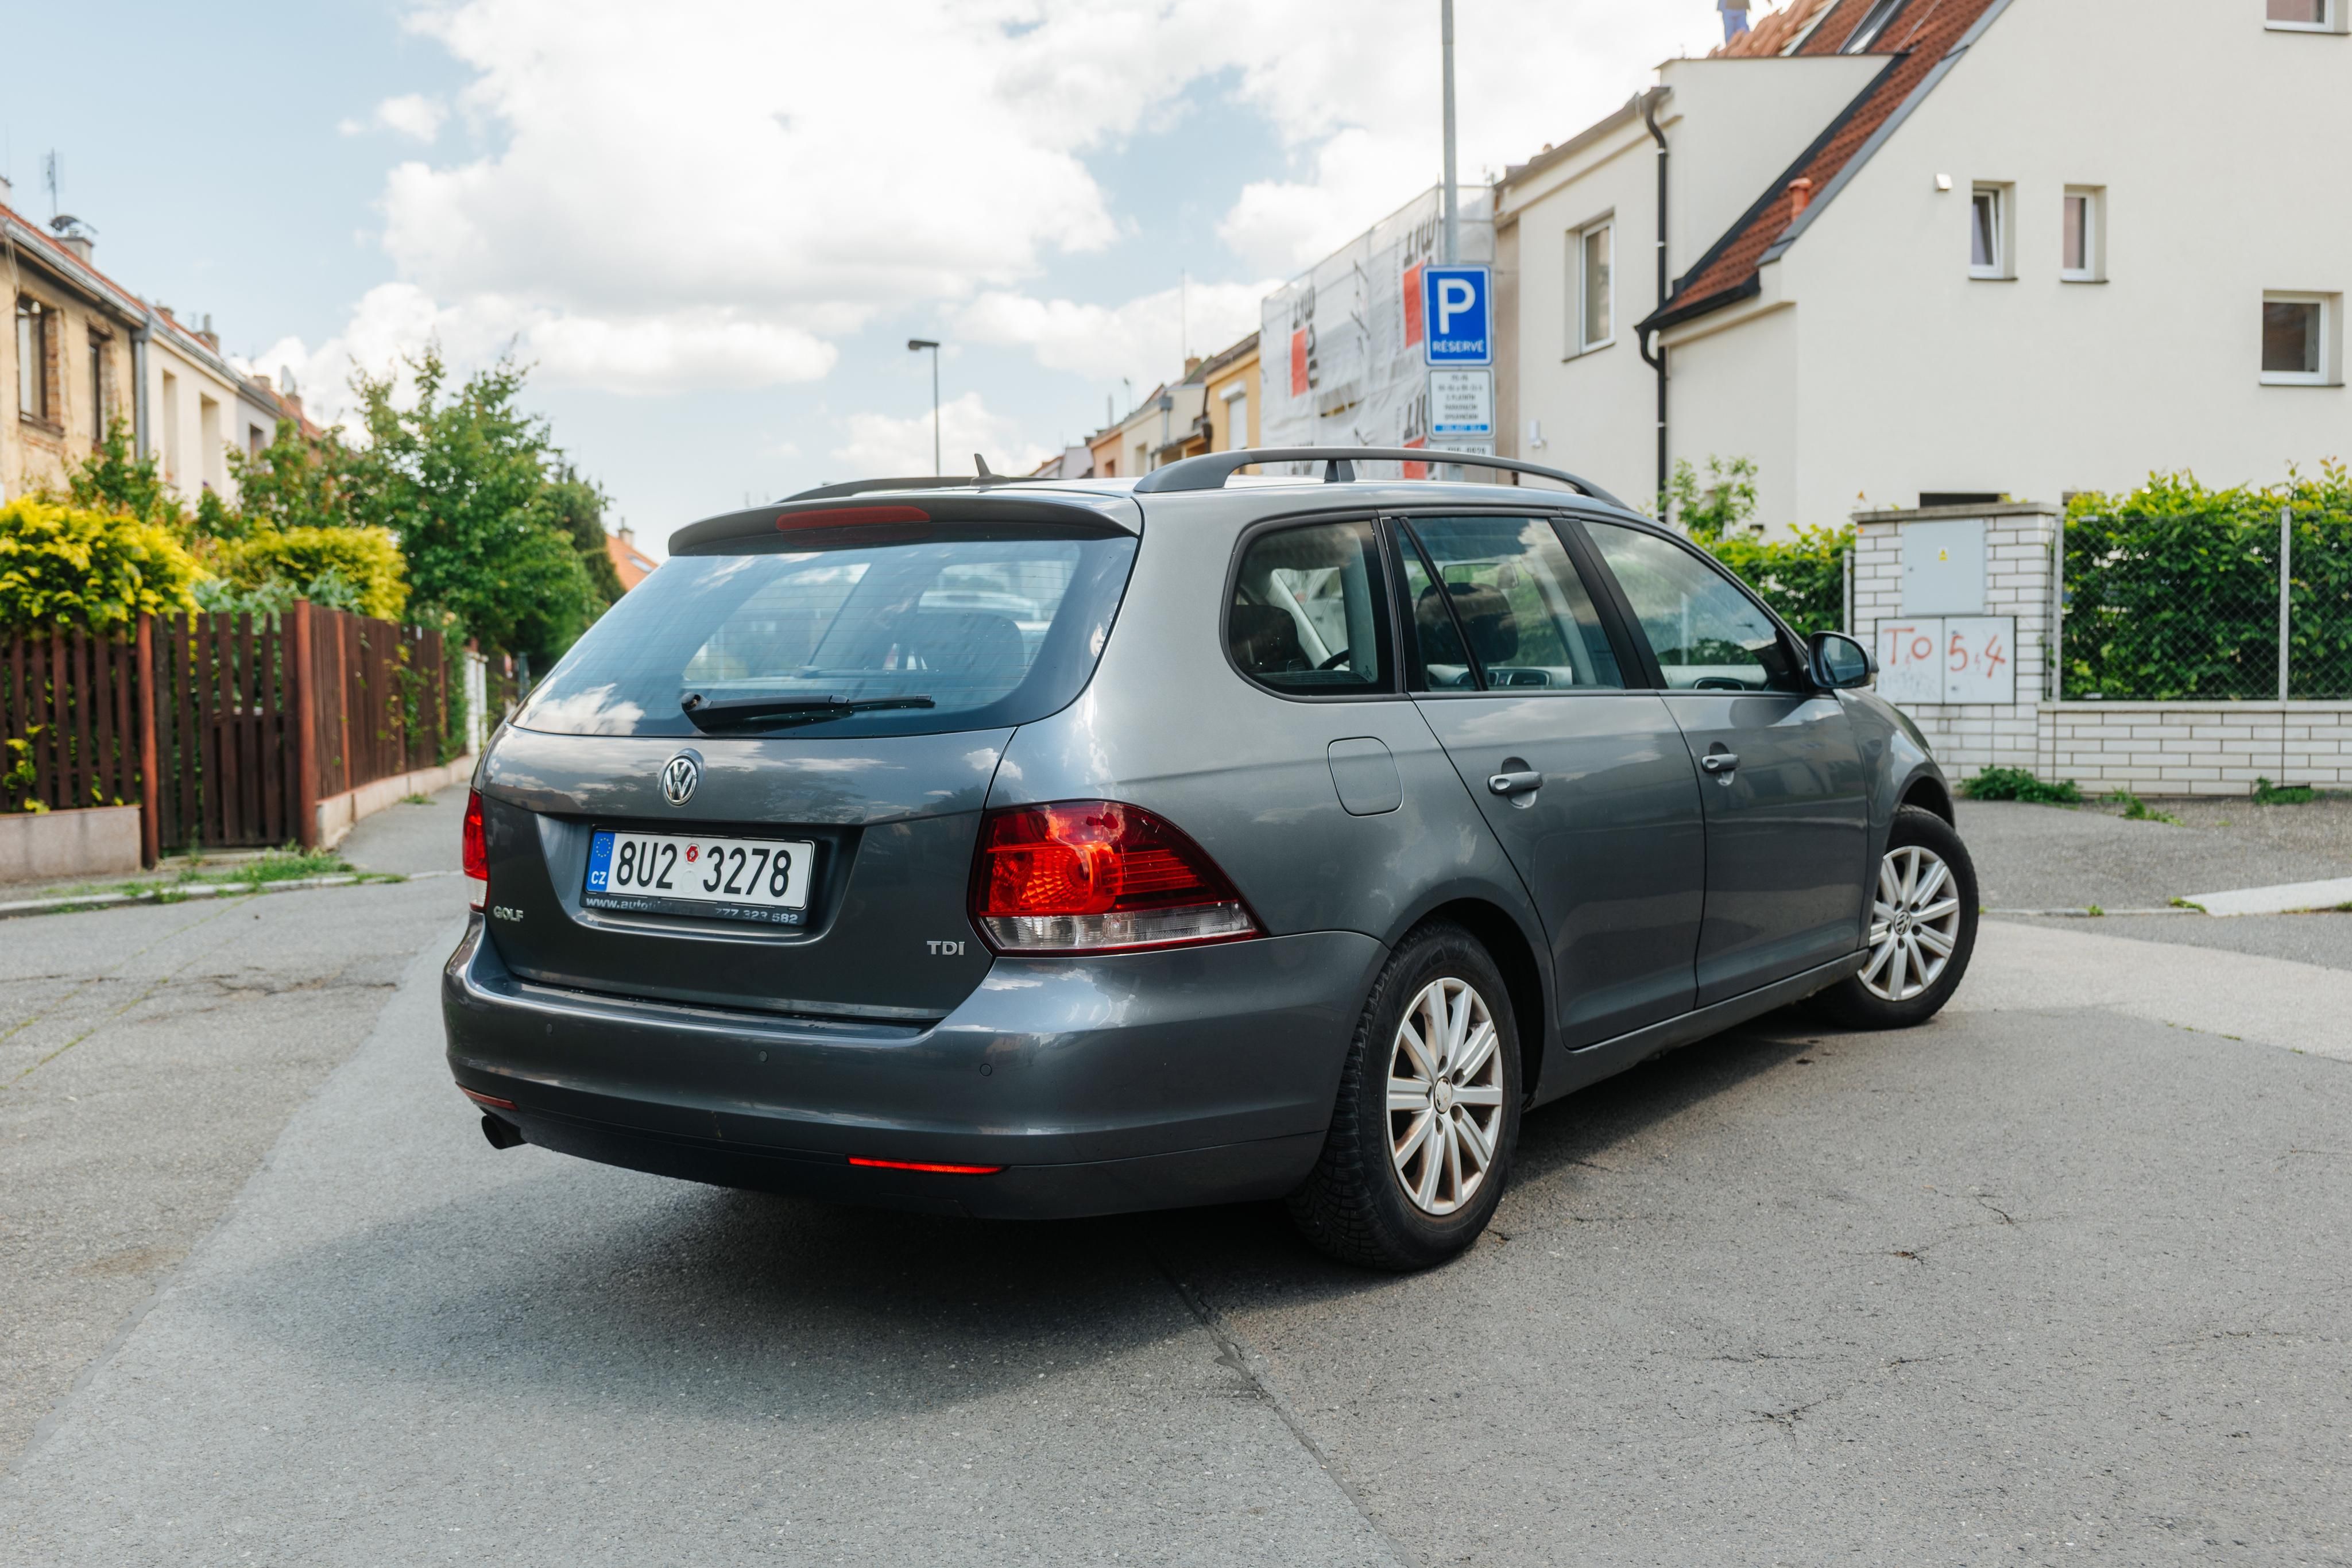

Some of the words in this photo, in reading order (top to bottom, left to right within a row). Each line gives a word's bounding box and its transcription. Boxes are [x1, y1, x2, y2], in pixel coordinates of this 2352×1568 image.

[1437, 278, 1476, 335] P
[664, 758, 697, 805] VW
[591, 870, 607, 885] CZ
[616, 841, 678, 889] 8U2
[703, 846, 792, 897] 3278
[493, 905, 524, 922] GOLF
[772, 913, 799, 924] 582
[926, 940, 965, 955] TDI
